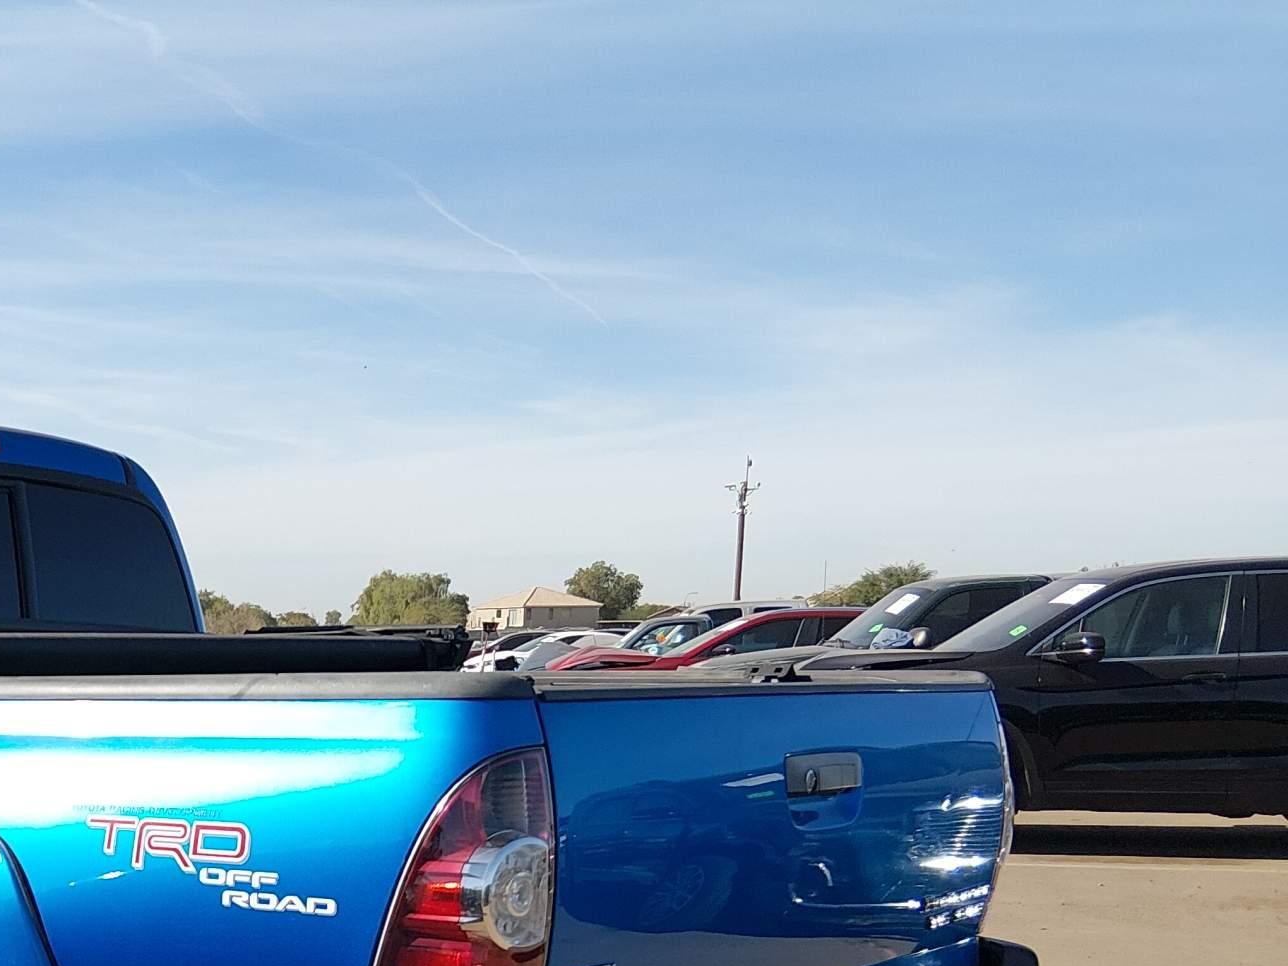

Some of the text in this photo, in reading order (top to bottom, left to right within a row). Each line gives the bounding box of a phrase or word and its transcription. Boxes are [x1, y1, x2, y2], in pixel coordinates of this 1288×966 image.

[86, 814, 251, 874] TRD
[199, 867, 279, 889] OFF
[221, 890, 337, 917] ROAD
